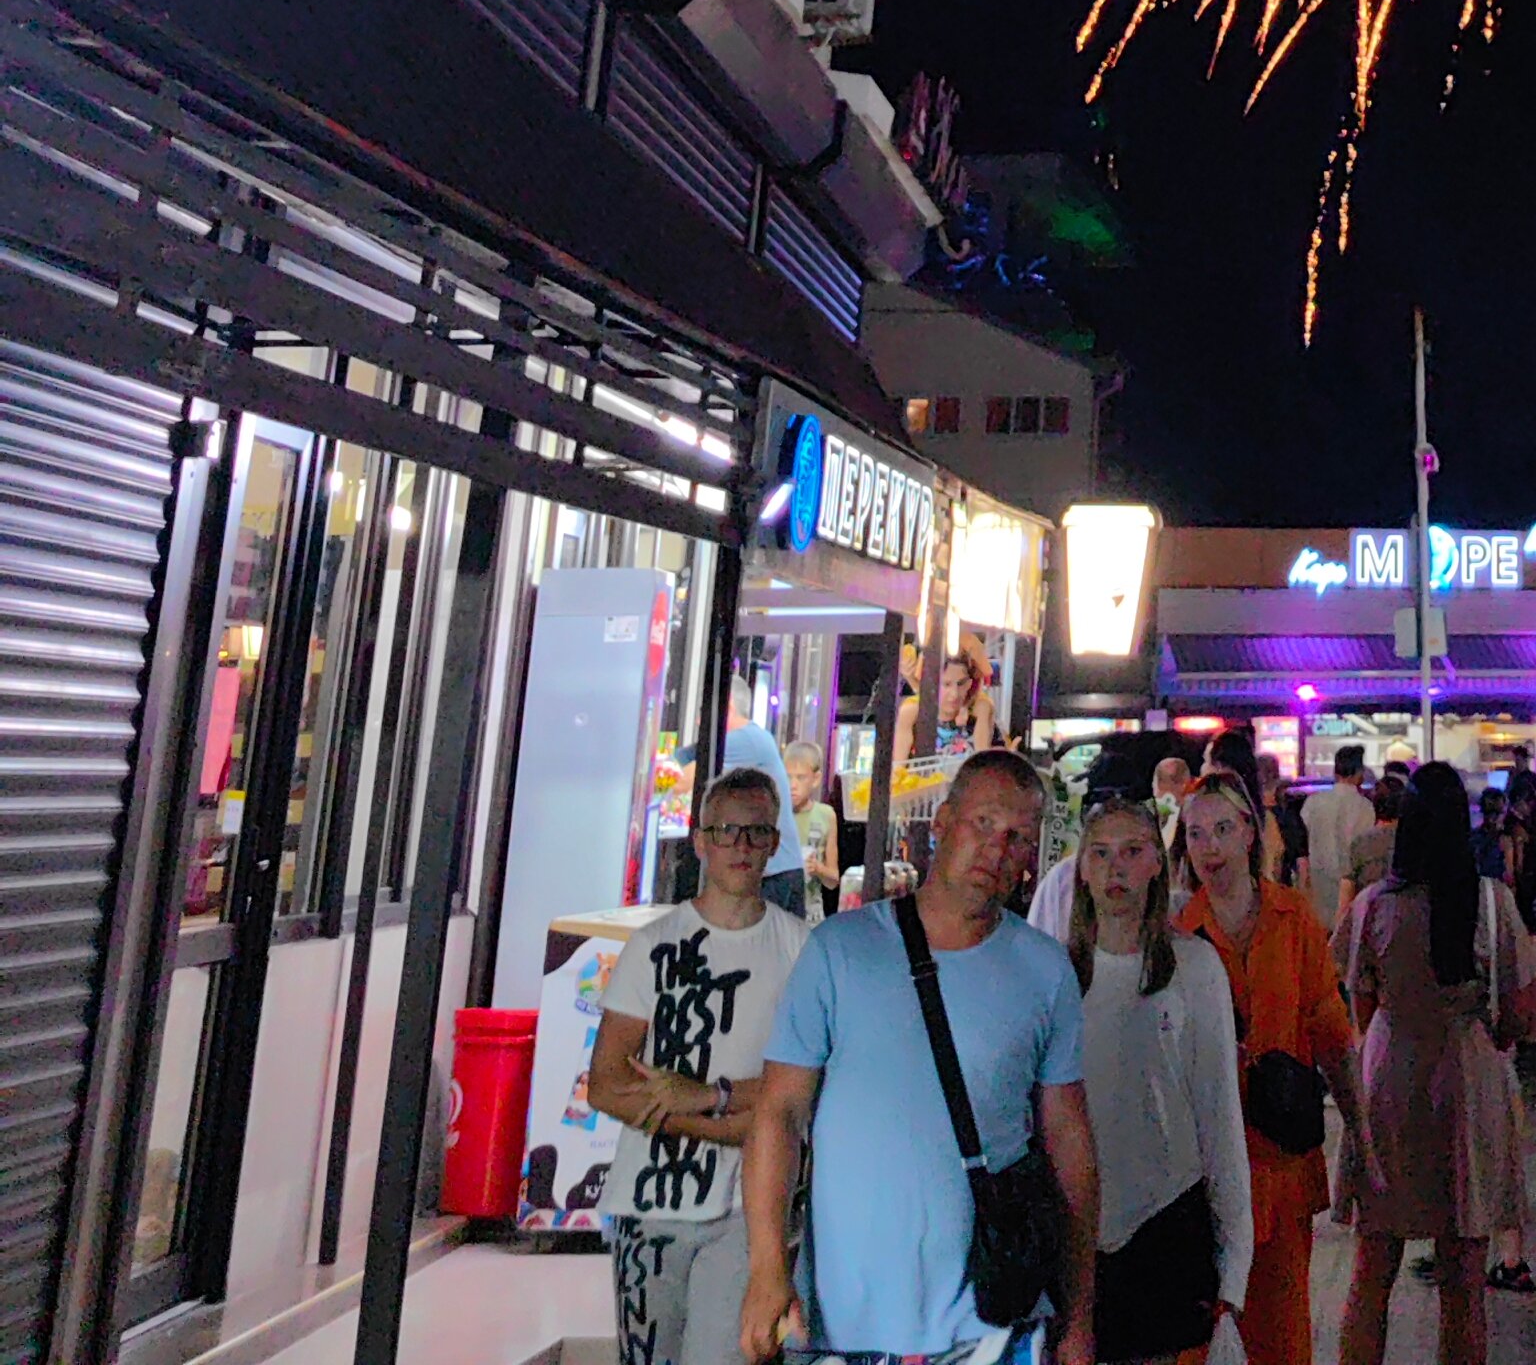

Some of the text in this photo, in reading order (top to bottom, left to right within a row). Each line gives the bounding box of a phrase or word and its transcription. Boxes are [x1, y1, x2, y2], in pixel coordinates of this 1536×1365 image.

[818, 434, 934, 571] ПЕРЕКУР
[1355, 525, 1518, 591] МОРЕ
[650, 927, 710, 994] THE
[653, 968, 751, 1066] BEST
[633, 1149, 717, 1212] CITY
[615, 1235, 676, 1295] EST
